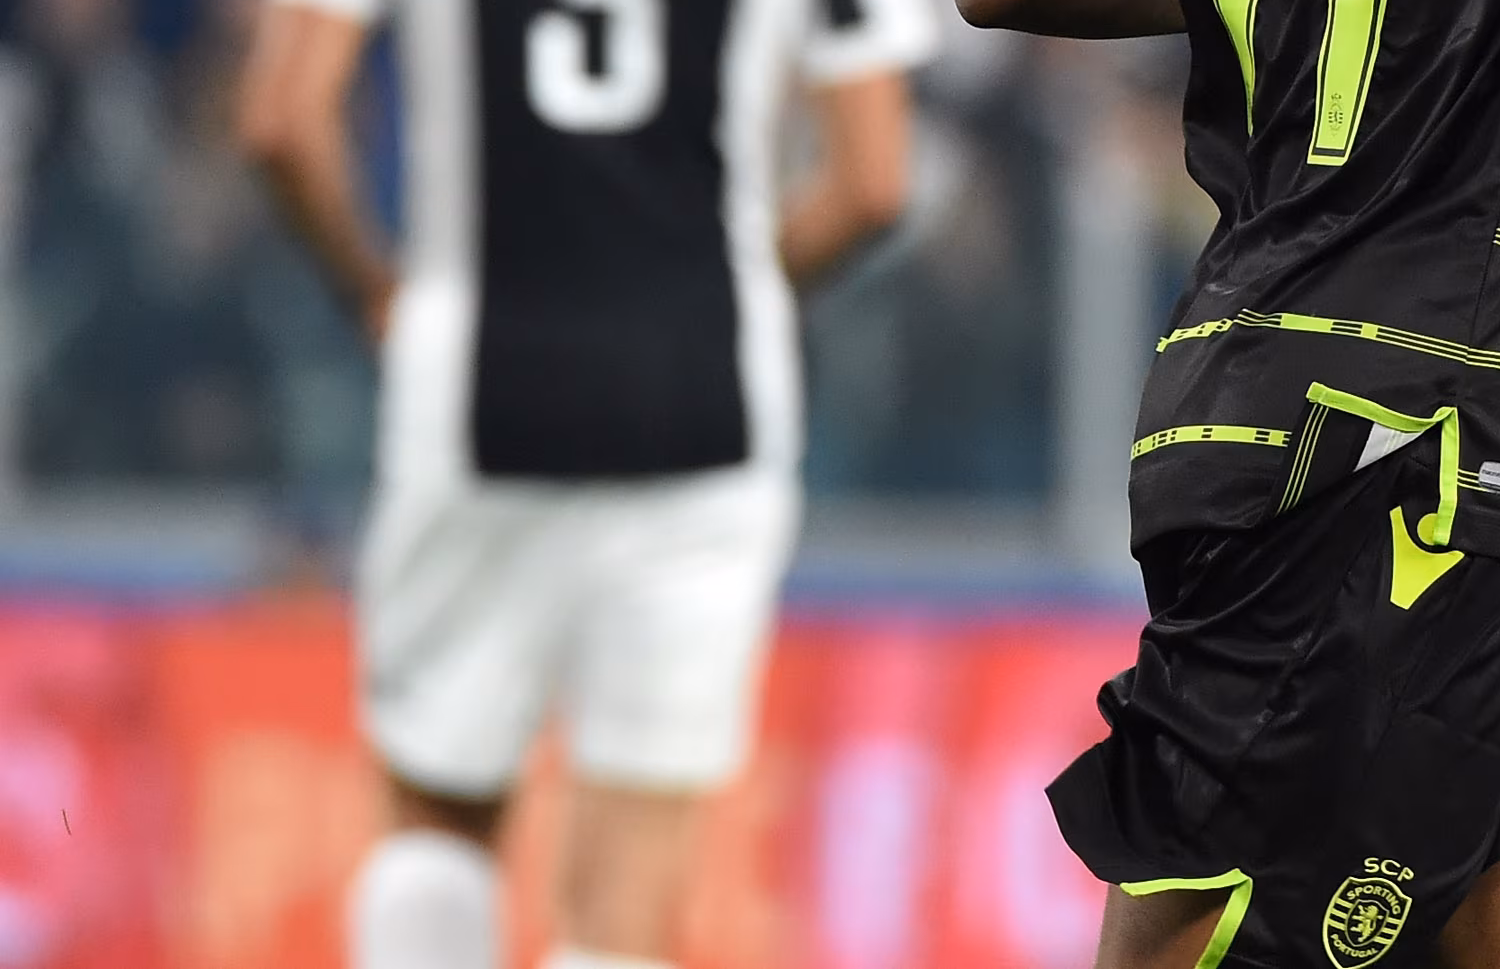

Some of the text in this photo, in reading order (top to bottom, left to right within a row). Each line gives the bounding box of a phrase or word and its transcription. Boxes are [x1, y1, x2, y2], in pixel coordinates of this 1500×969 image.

[1363, 856, 1415, 882] SCP
[1346, 884, 1401, 915] SPORTING
[1330, 933, 1380, 958] PORTUGAL
